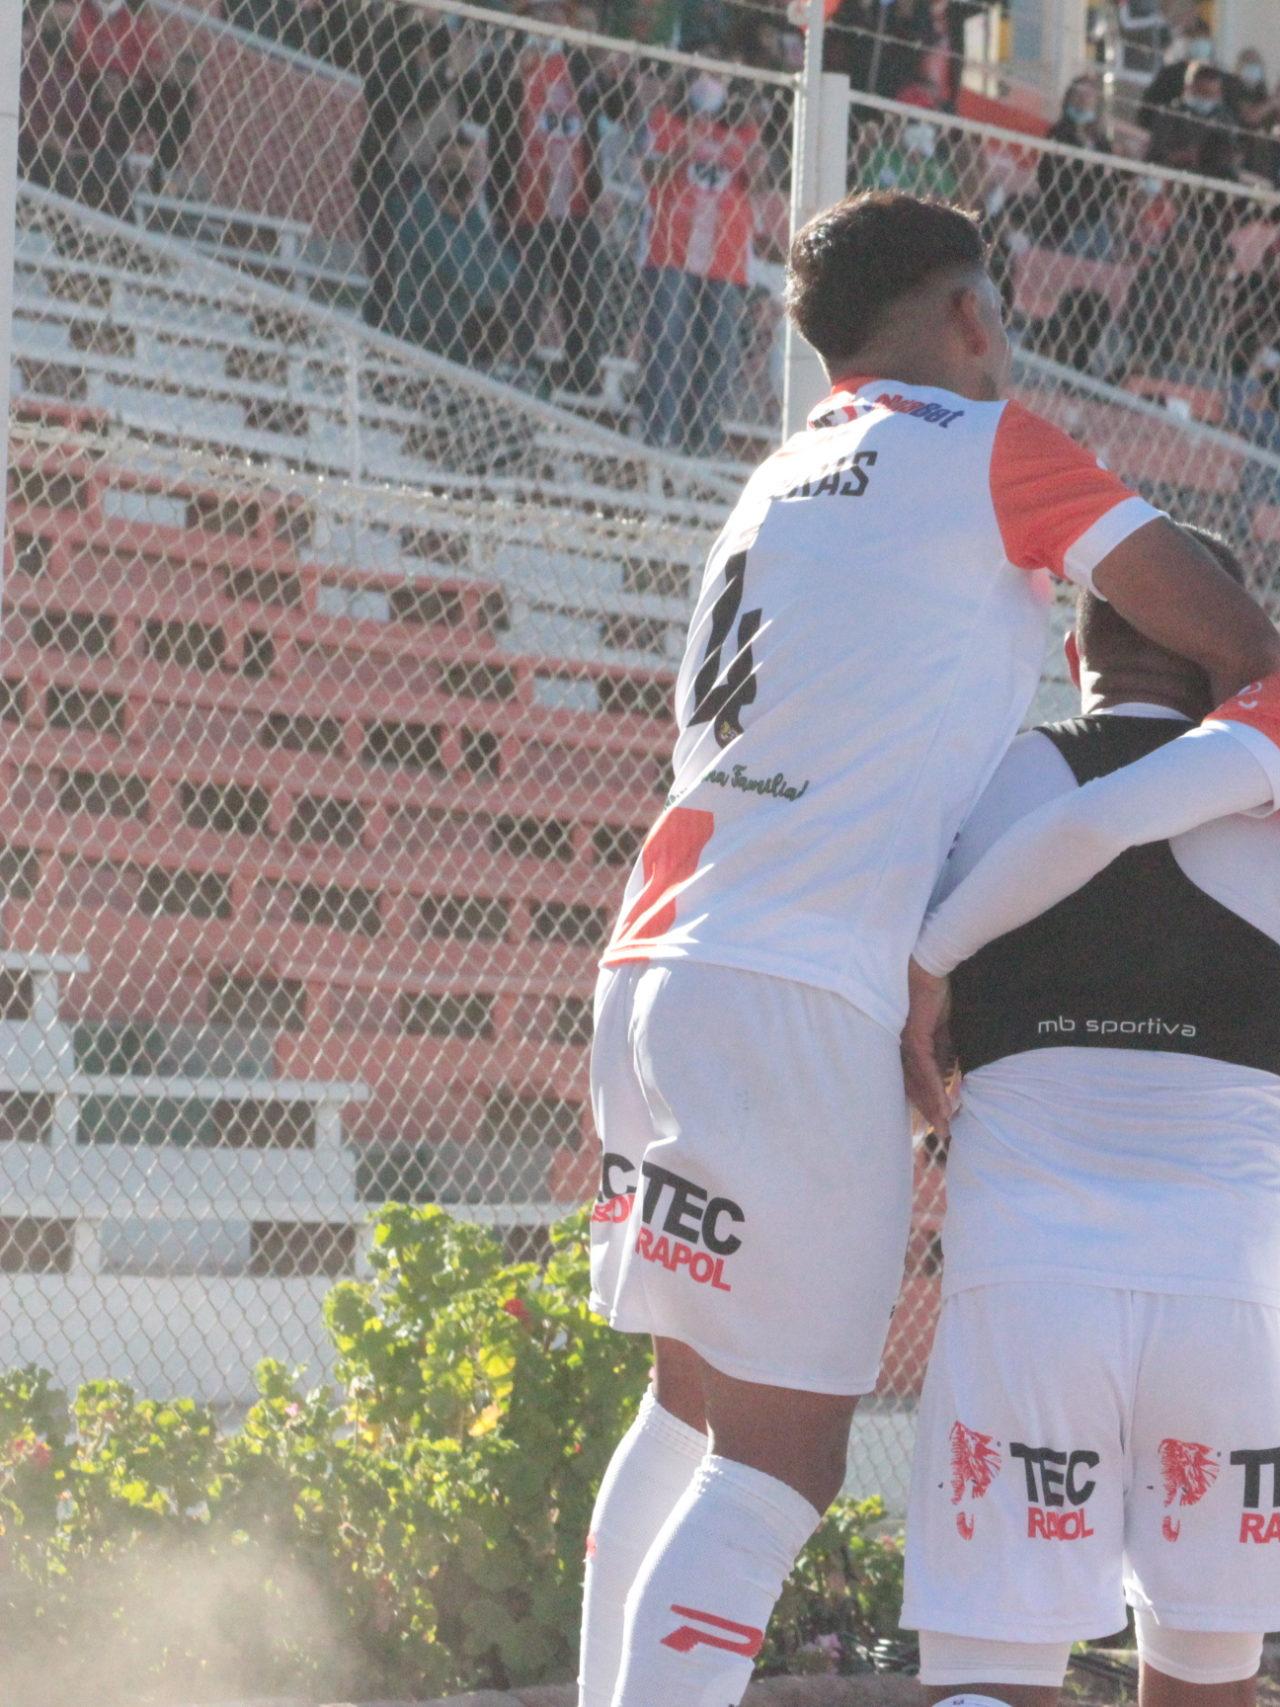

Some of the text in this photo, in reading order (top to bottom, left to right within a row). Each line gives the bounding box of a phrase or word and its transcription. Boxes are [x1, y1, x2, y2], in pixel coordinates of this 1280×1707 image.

[1038, 1015, 1197, 1037] mb sportiva
[641, 1160, 746, 1256] TEC
[634, 1227, 733, 1293] RAPOL
[1010, 1442, 1100, 1508] TEC
